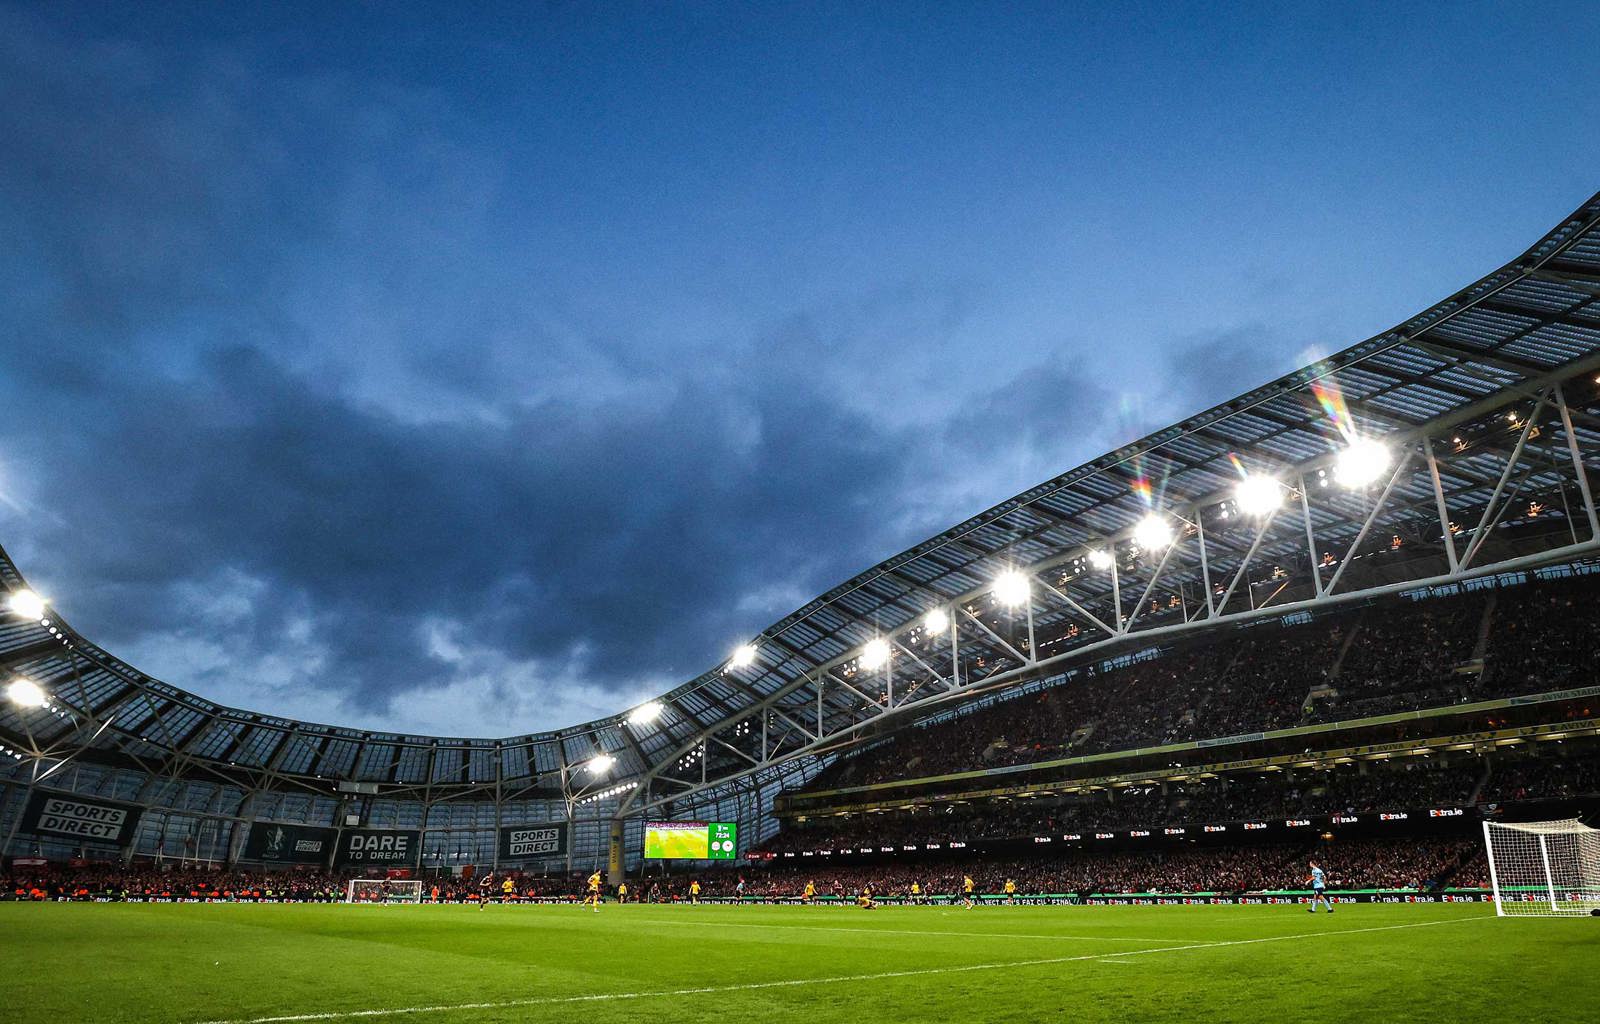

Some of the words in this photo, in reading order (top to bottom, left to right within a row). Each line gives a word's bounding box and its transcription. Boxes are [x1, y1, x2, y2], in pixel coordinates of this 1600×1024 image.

[49, 801, 122, 822] SPORTS
[1429, 808, 1463, 818] Extra.ie
[1332, 815, 1358, 824] Etra.ie
[1380, 812, 1408, 821] Extra.ie
[43, 817, 116, 837] DIRECT
[1244, 823, 1267, 831] Extra.ie
[1286, 820, 1311, 828] Extra.ie
[514, 830, 556, 841] SPORTS
[349, 835, 409, 851] DARE
[513, 842, 555, 854] DIRECT
[348, 851, 363, 860] TO
[370, 851, 406, 860] DREAM
[1182, 897, 1205, 905] Extra.ie
[1209, 897, 1233, 905] Extra.ie
[1238, 896, 1263, 904] Extra.ie
[1266, 896, 1292, 904] Extra.ie
[1329, 896, 1356, 904] Extra.ie
[1370, 895, 1399, 903] Era.ie
[1404, 895, 1434, 903] Extra.ie
[1441, 894, 1473, 903] Extra.ie
[1481, 894, 1514, 903] Ext.ie
[1521, 894, 1552, 903] Extra.i
